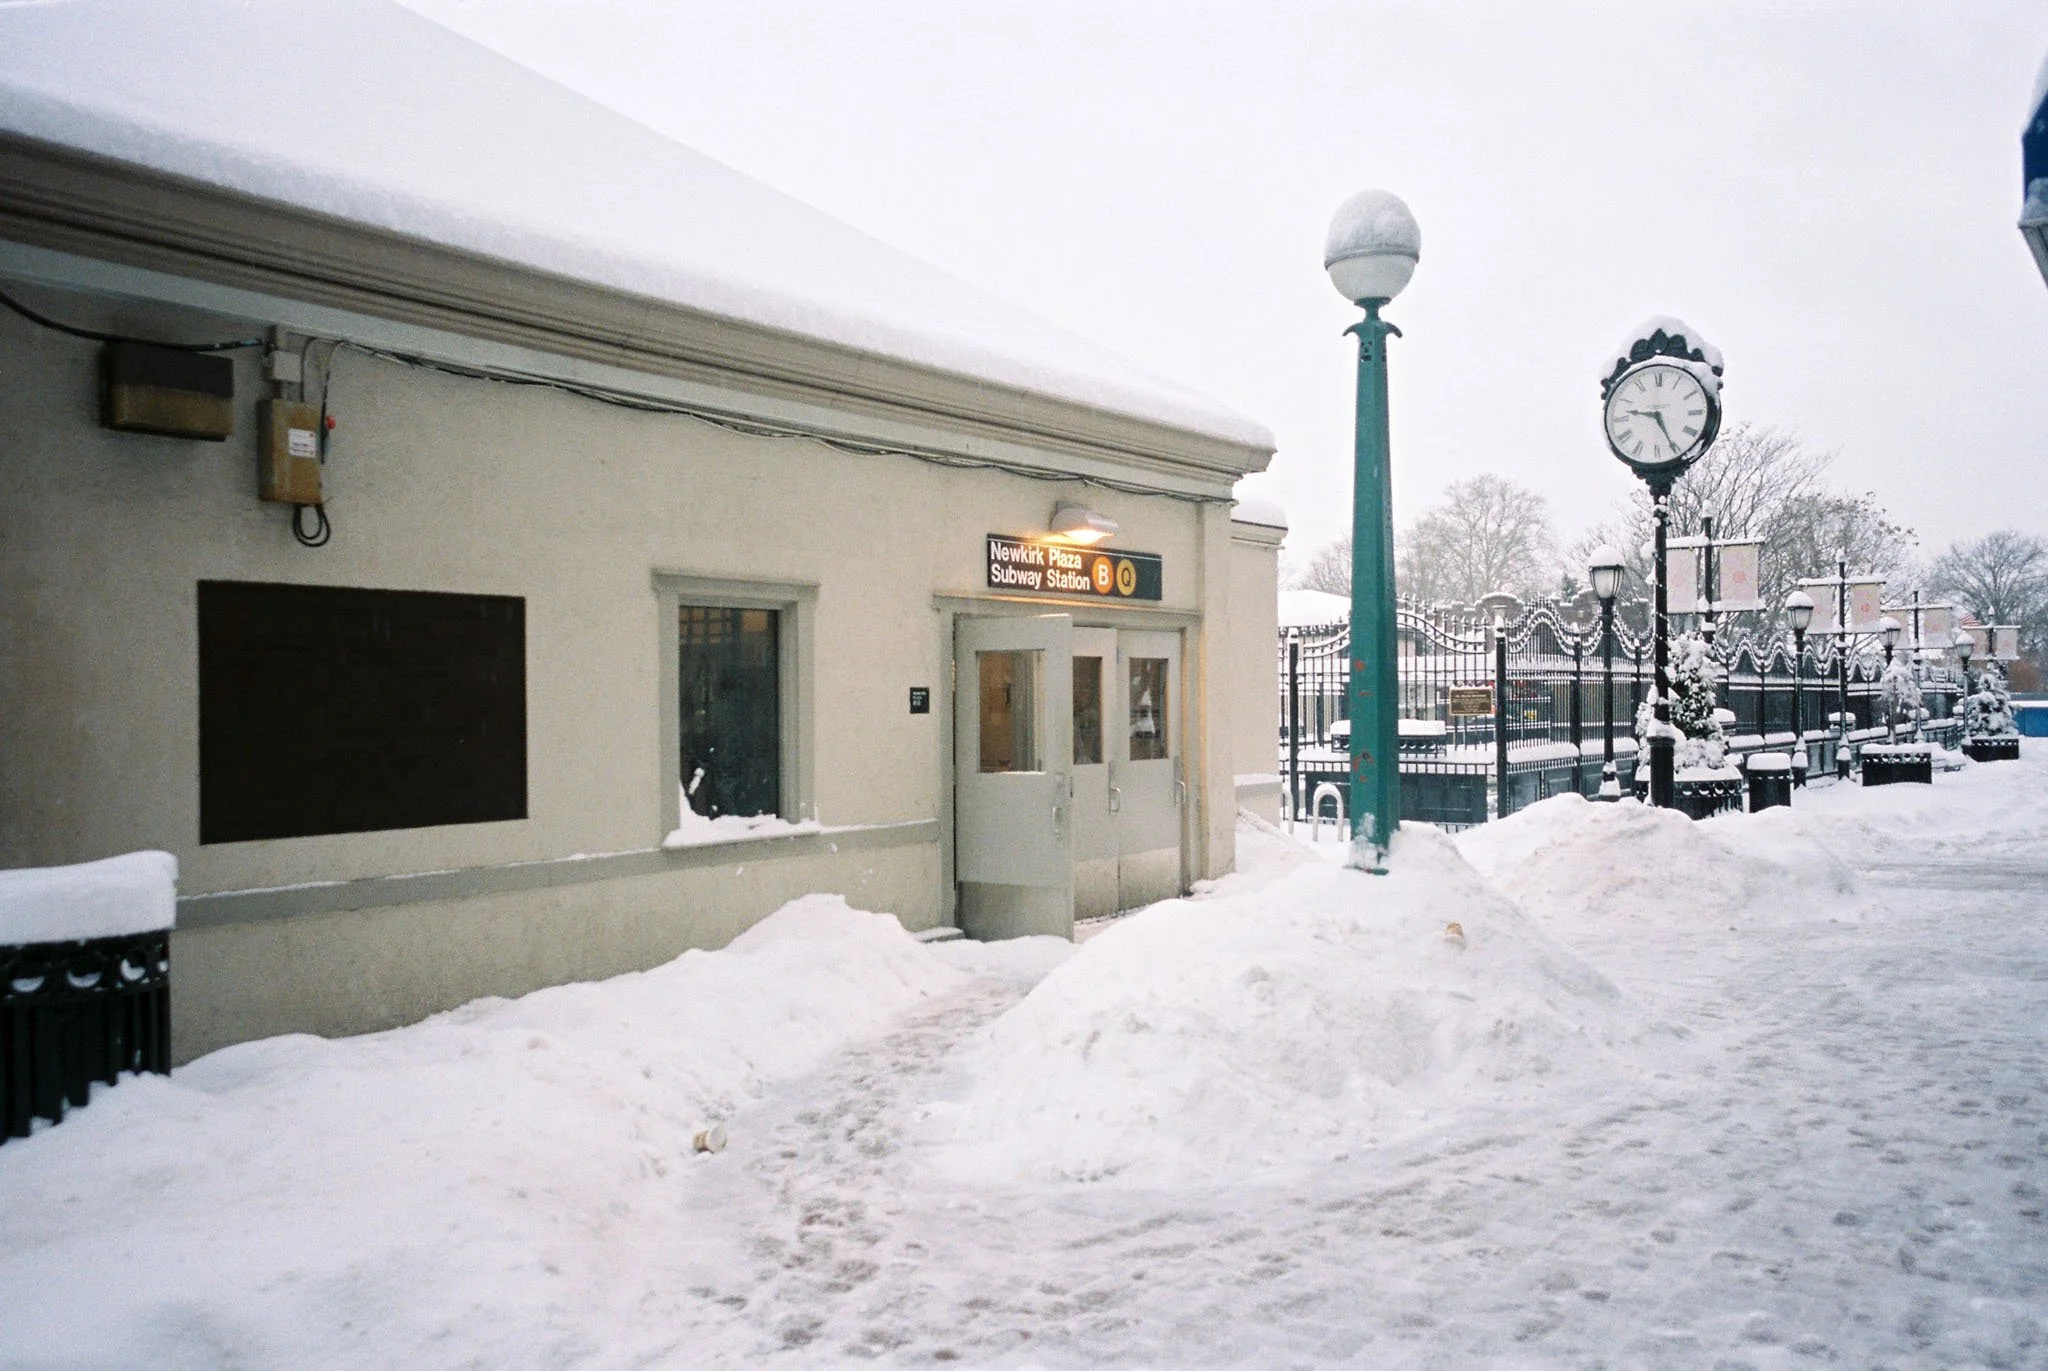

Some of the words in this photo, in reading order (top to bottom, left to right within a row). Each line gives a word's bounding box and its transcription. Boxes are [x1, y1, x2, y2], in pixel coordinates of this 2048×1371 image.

[990, 541, 1044, 565] Newkirk
[1049, 548, 1082, 569] Plaza
[991, 563, 1042, 589] Subway
[1047, 569, 1090, 590] Station
[1098, 565, 1109, 585] B
[1121, 567, 1131, 587] Q
